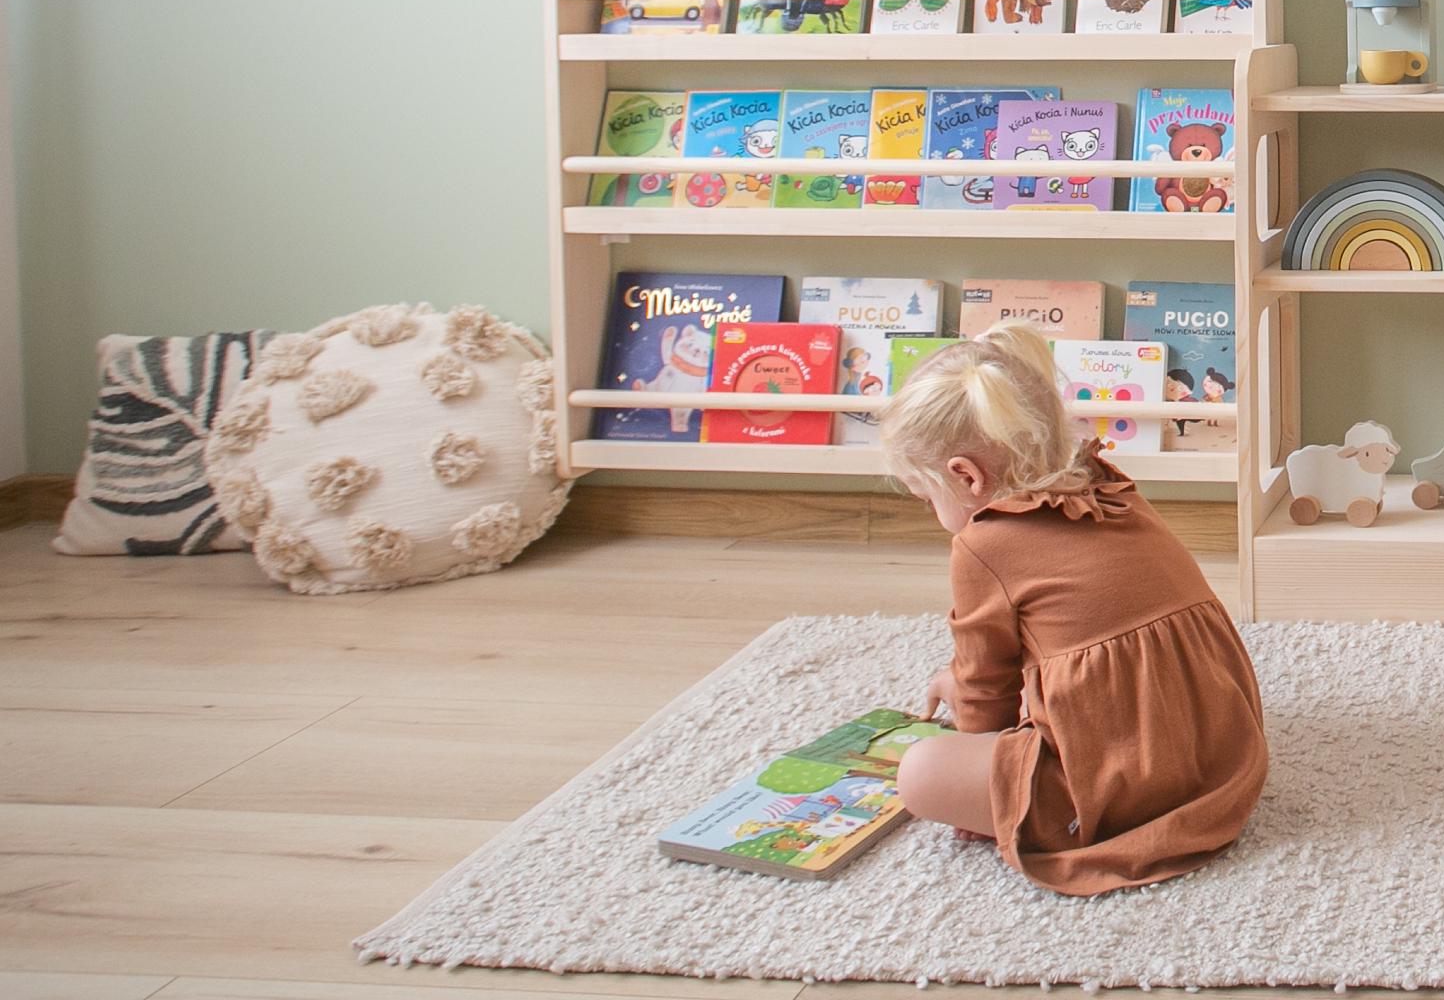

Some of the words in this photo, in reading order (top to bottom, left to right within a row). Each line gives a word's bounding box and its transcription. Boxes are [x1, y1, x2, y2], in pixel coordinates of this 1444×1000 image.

[892, 20, 910, 31] Eric
[913, 19, 940, 31] Carle
[1095, 20, 1113, 31] Eric
[1116, 19, 1142, 31] Carle
[608, 112, 645, 135] Kicia
[648, 102, 684, 119] Kocia
[691, 111, 729, 134] Kicia
[730, 100, 772, 118] Kocia
[787, 111, 826, 134] Kicia
[828, 100, 869, 119] Kocia
[875, 111, 914, 134] Kicia
[935, 111, 973, 135] Kicia
[1009, 115, 1034, 133] Kicia
[1035, 108, 1062, 121] Kocia
[1064, 107, 1068, 116] i
[1070, 107, 1103, 116] Nunuś
[640, 287, 724, 319] Misiu,
[1080, 357, 1133, 379] Kolory
